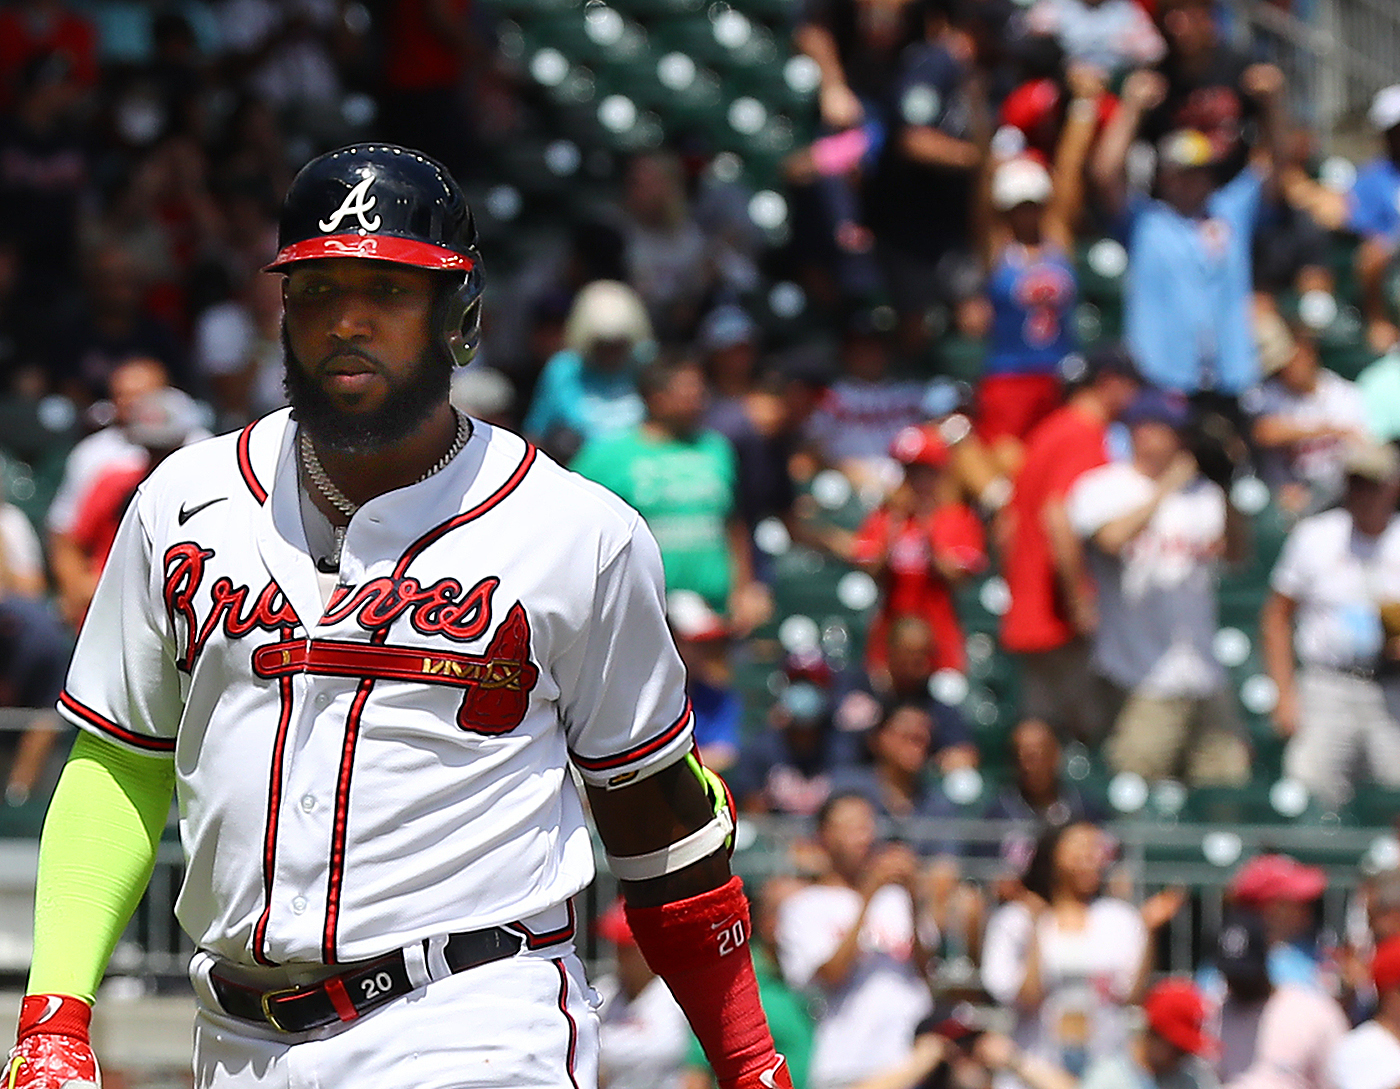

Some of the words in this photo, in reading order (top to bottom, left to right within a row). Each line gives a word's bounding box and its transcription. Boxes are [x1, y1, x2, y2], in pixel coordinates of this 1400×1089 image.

[318, 175, 381, 233] A
[163, 541, 500, 674] Braves
[716, 919, 745, 957] 20
[360, 971, 393, 999] 20
